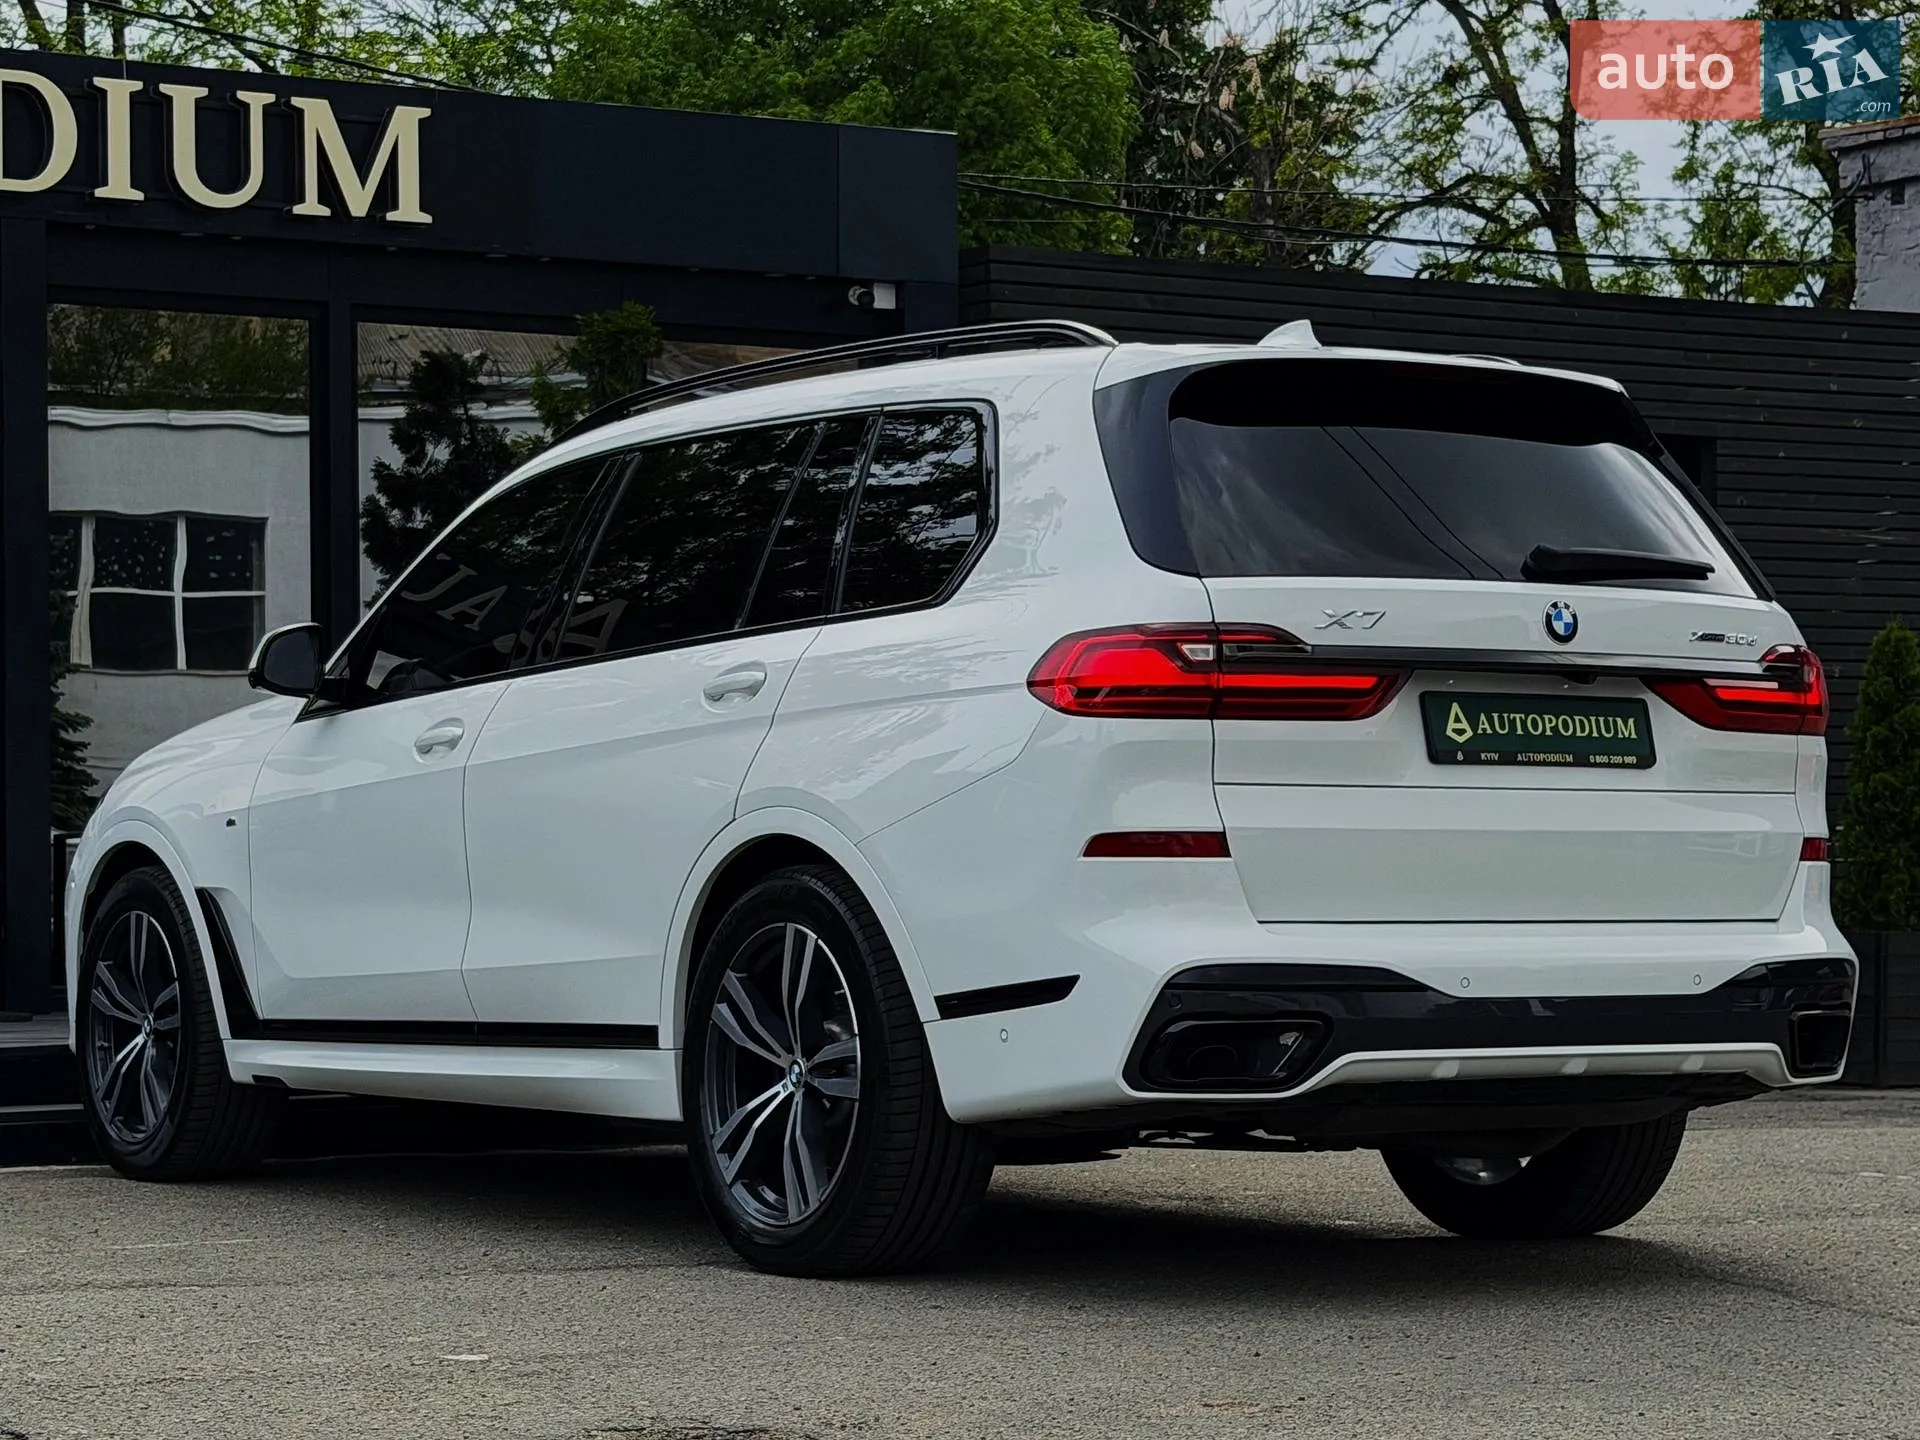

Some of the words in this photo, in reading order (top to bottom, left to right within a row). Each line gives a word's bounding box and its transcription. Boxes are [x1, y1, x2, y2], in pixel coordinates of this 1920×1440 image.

[0, 69, 433, 224] DIUM
[1314, 608, 1386, 629] X7
[1477, 711, 1637, 739] AUTOPODIUM
[1480, 752, 1499, 761] KYIV
[1516, 752, 1573, 763] AUTOPODIUM
